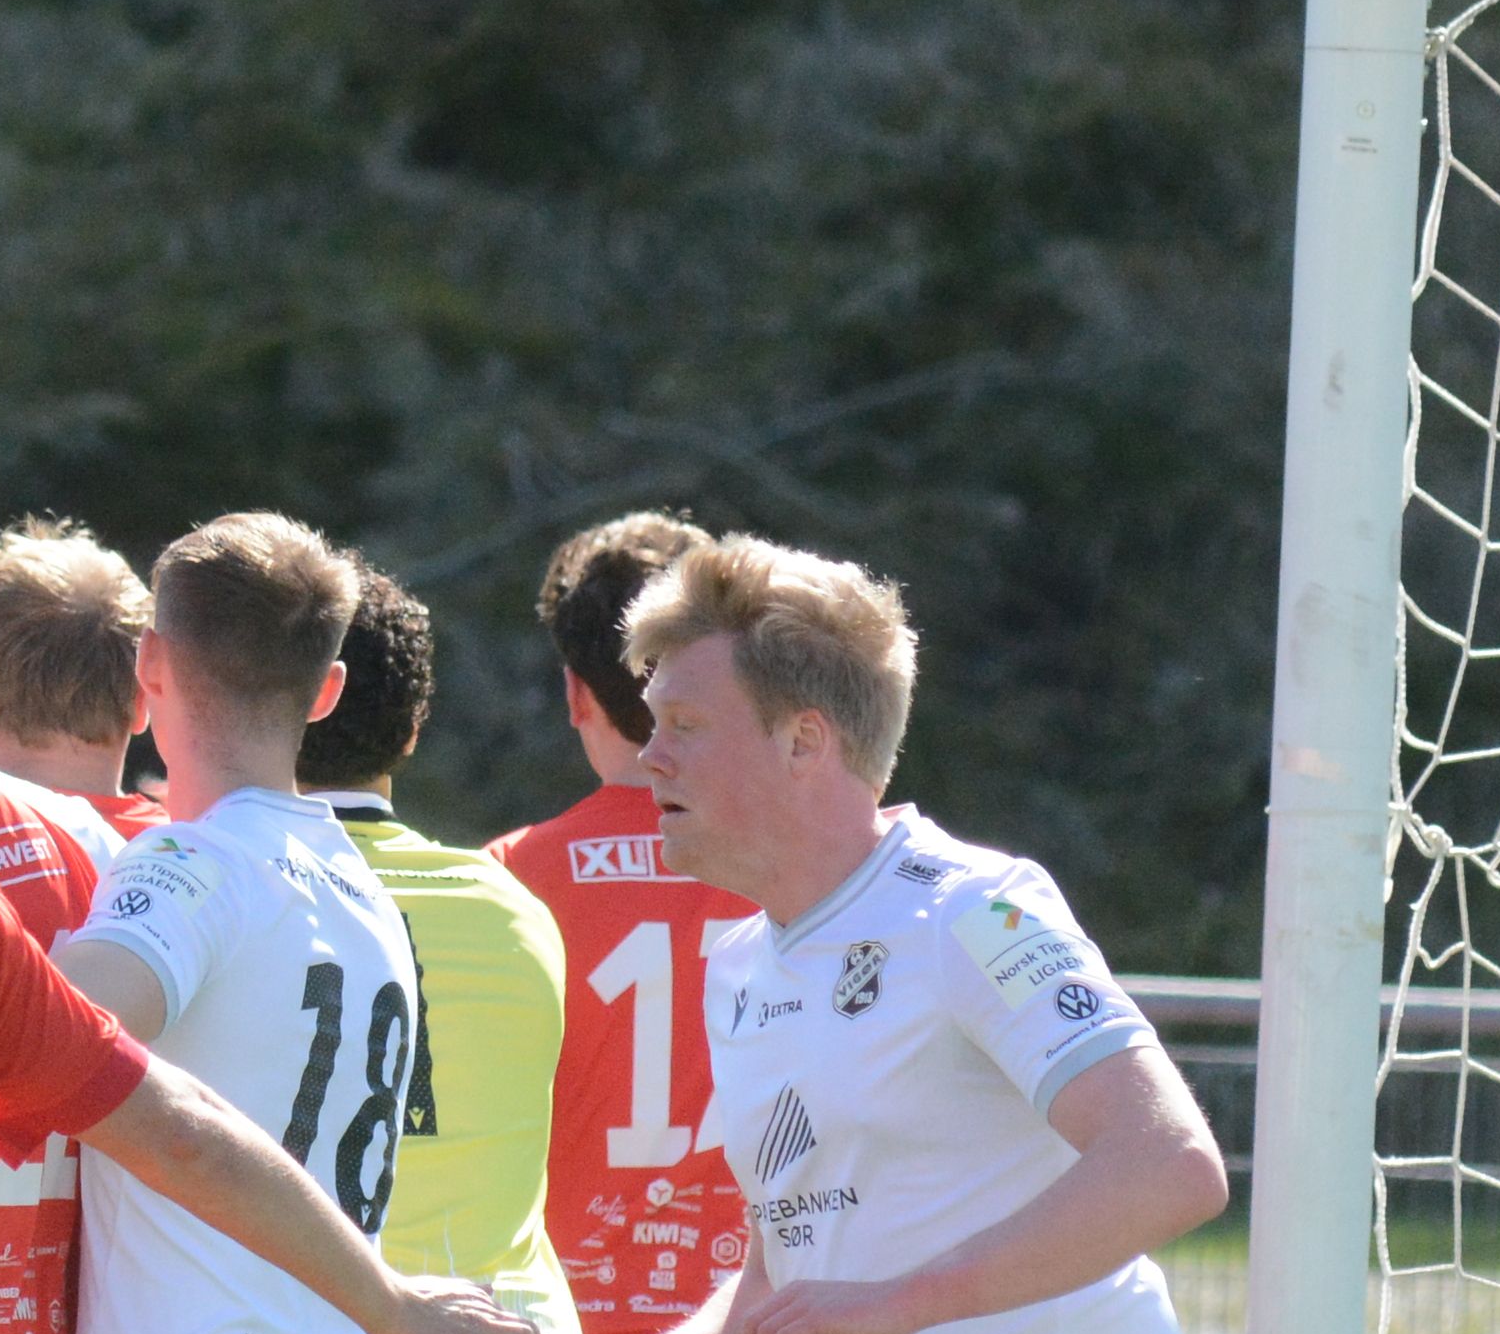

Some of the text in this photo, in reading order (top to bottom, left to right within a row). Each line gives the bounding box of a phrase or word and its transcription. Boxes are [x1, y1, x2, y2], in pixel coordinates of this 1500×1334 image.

[576, 841, 648, 877] XL
[995, 952, 1038, 986] Norsk
[1028, 956, 1086, 986] LIGAEN
[770, 999, 803, 1018] EXTRA
[282, 962, 410, 1234] 18
[633, 1222, 681, 1244] KIWI
[777, 1225, 815, 1248] SØR
